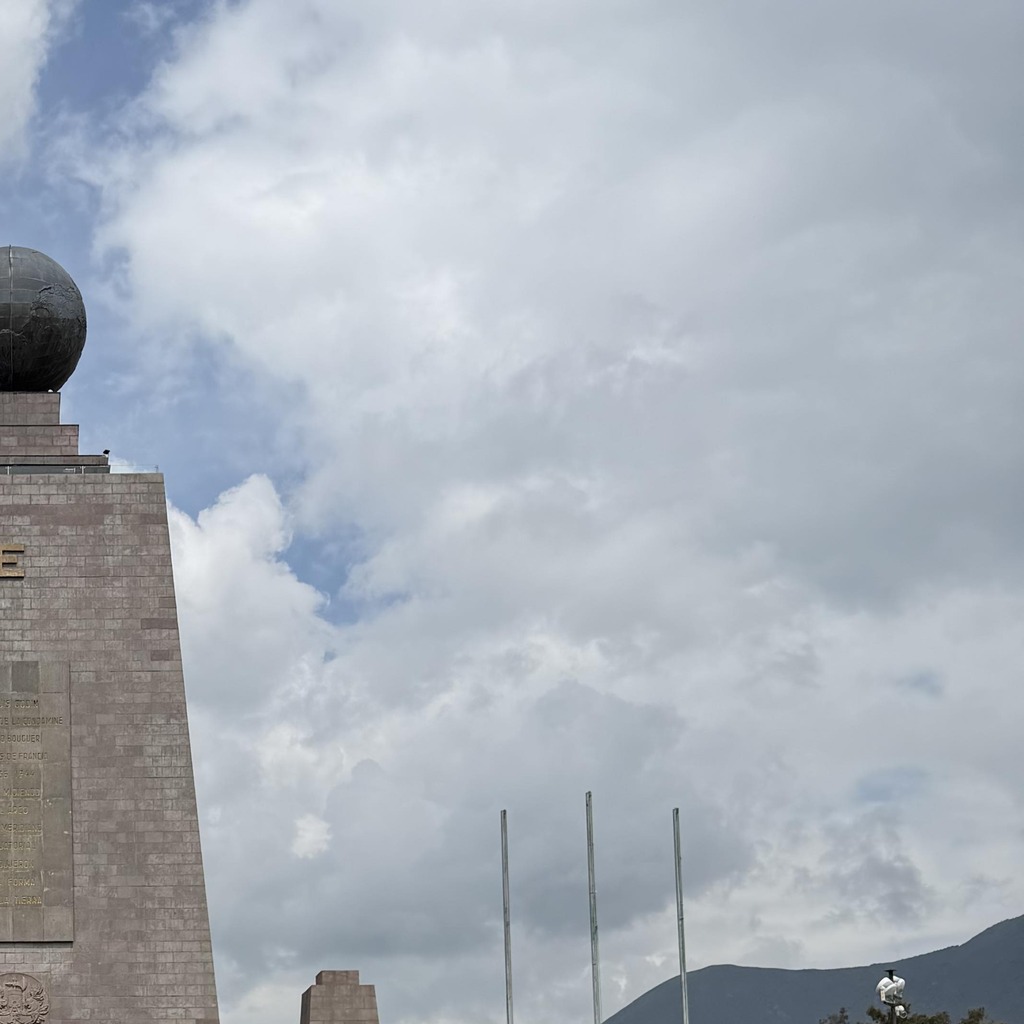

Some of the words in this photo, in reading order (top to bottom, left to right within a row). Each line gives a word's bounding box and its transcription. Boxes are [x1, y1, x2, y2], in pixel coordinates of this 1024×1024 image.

[0, 717, 9, 726] DE
[6, 752, 17, 761] DE
[18, 752, 48, 761] FRANCIA
[7, 878, 36, 887] FORMA
[14, 896, 43, 905] TIERRA
